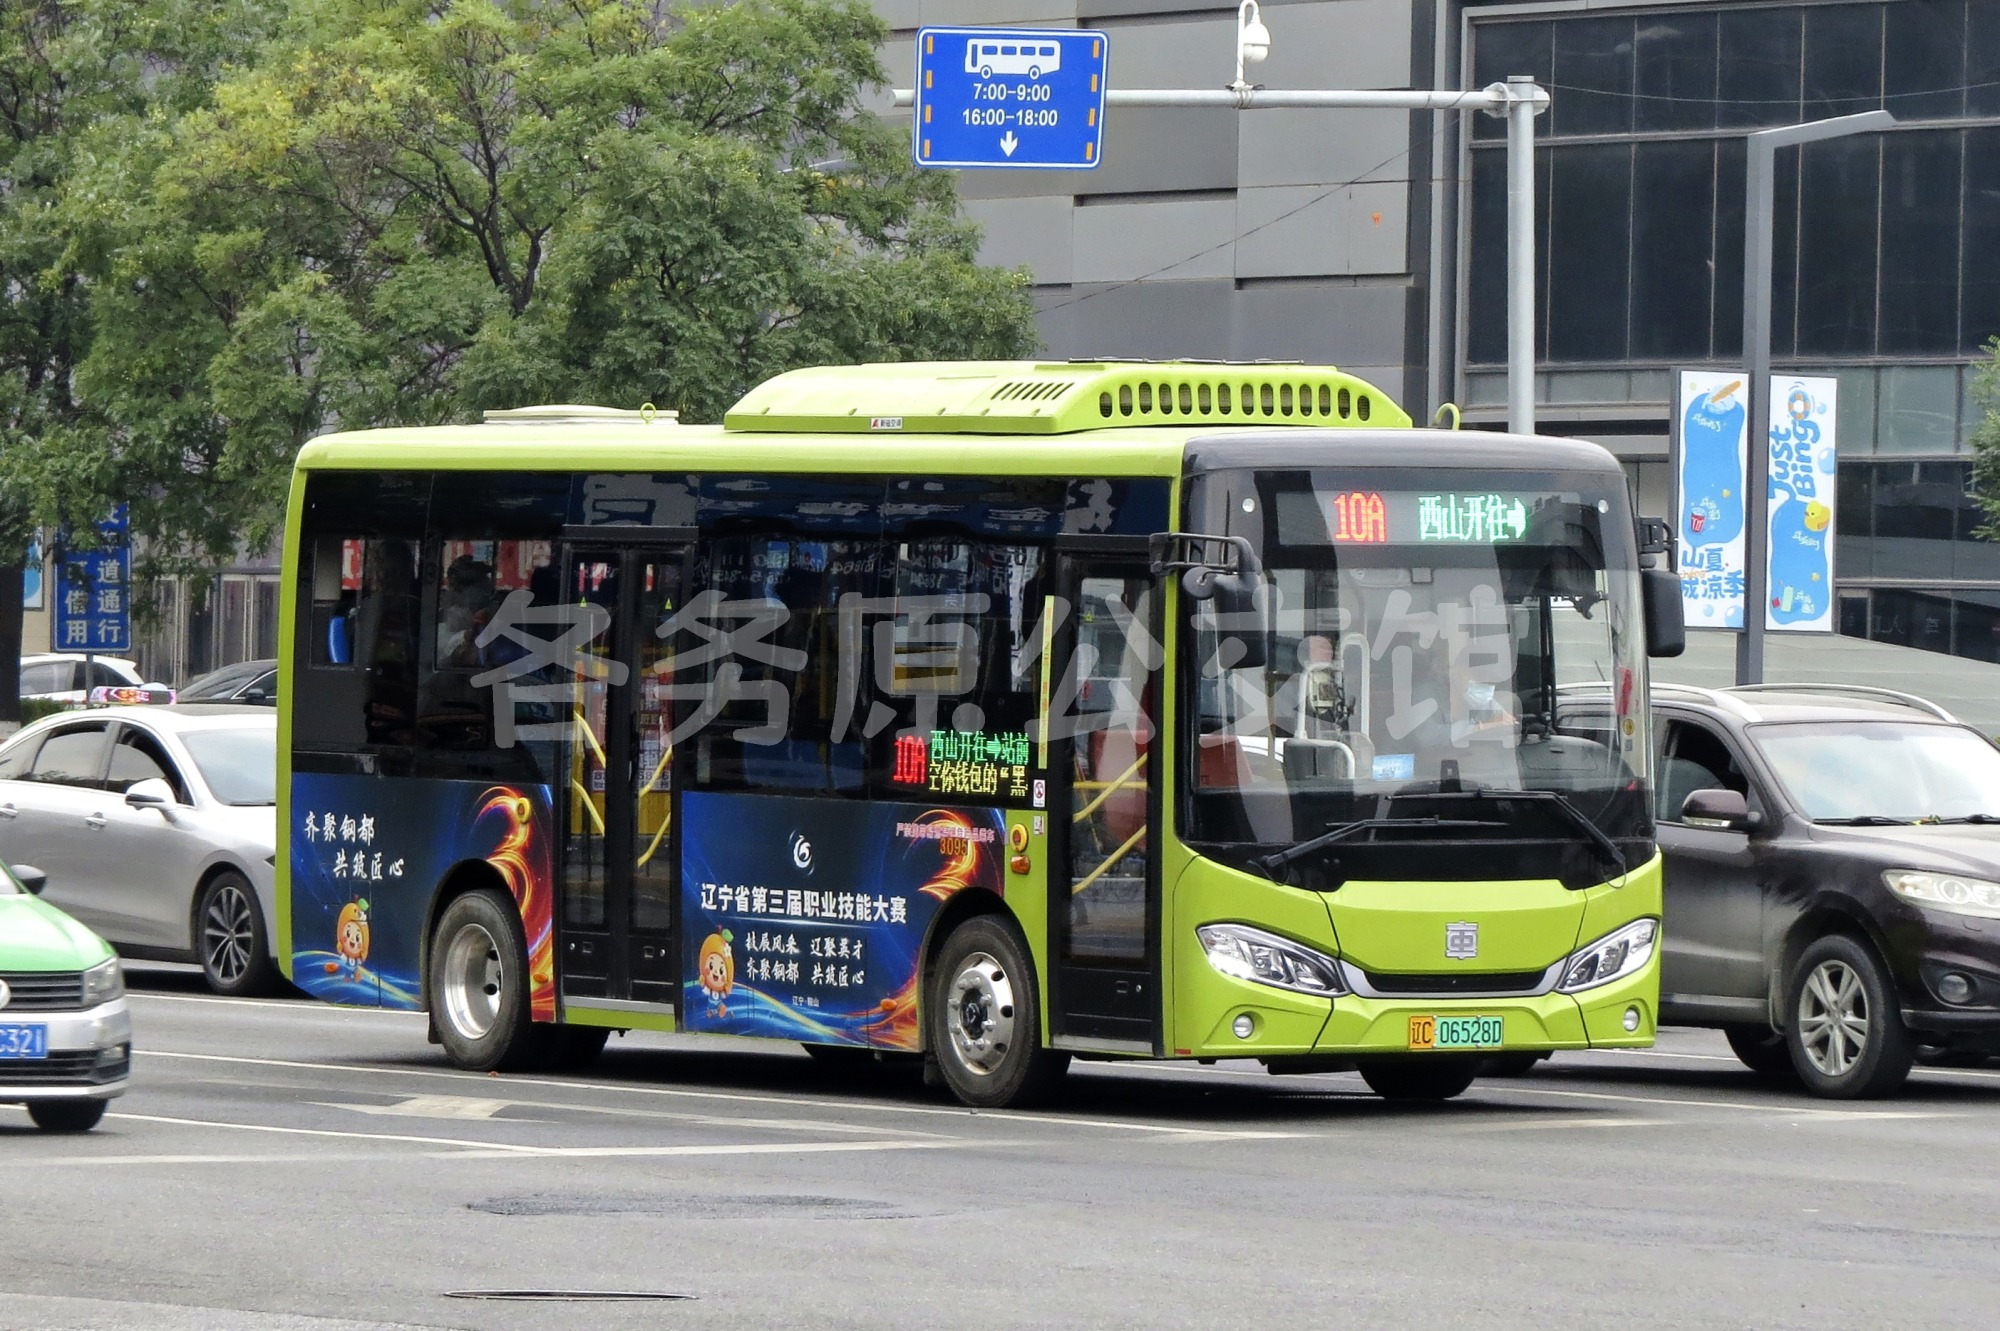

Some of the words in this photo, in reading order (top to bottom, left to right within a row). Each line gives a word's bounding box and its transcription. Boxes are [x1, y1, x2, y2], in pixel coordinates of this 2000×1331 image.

[973, 83, 1051, 101] 7:00-9:00
[962, 108, 1058, 126] 16:00-18:00
[1768, 424, 1796, 499] Just
[1791, 419, 1820, 498] Bing
[1334, 491, 1386, 542] 10A
[893, 736, 926, 784] 10A
[304, 811, 375, 847] 齐聚钢都
[940, 837, 968, 855] 3095
[332, 848, 405, 880] 共筑匠心
[701, 882, 907, 924] 辽宁省第三届职业技能大赛
[746, 956, 800, 985] 齐聚钢都
[811, 961, 865, 987] 共筑匠心
